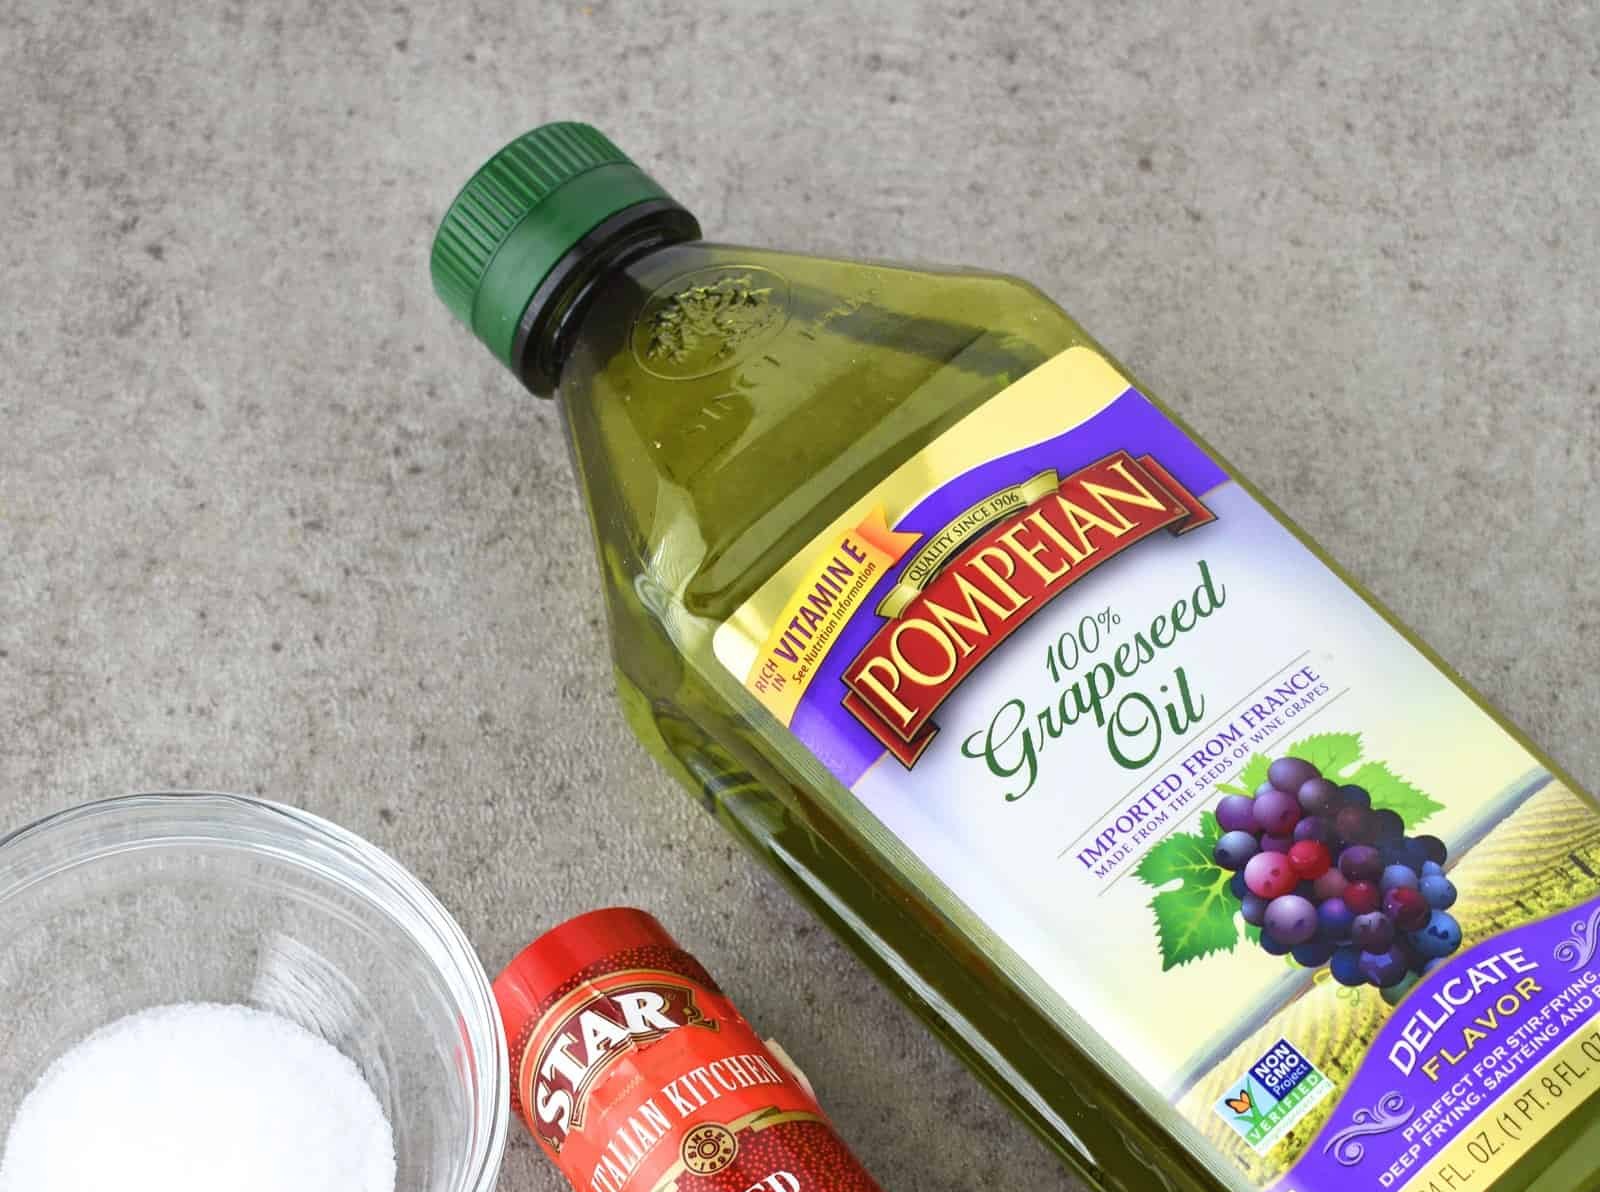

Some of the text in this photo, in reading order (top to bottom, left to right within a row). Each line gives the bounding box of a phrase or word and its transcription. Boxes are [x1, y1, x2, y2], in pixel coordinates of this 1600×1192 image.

[910, 491, 1020, 581] QUALITY SINCE 1906
[773, 538, 866, 664] VITAMIN E
[792, 562, 877, 685] See Nutrition Information
[855, 460, 1167, 729] POMPEIAN
[1046, 606, 1121, 683] 100%
[754, 658, 779, 694] RICH
[771, 673, 787, 693] IN
[961, 559, 1226, 802] Grapeseed
[1107, 666, 1205, 770] Oil
[1076, 666, 1320, 869] IMPORTED FROM FRANCE
[1094, 682, 1329, 879] MADE FROM THE SEEDS OF WINE GRAPES
[536, 991, 681, 1136] STAR
[1254, 1043, 1291, 1080] NON
[1388, 947, 1540, 1077] DELICATE
[1421, 976, 1543, 1082] FLAVOR
[661, 1054, 783, 1118] KITCHEN
[1250, 1074, 1319, 1140] VERIFIED
[1264, 1052, 1300, 1088] GMO
[1273, 1063, 1309, 1096] Project
[1378, 1143, 1422, 1188] DEEP
[1421, 1092, 1488, 1147] FRYING,
[1559, 995, 1593, 1027] AND
[1402, 1073, 1474, 1142] PERFECT
[1473, 1046, 1508, 1078] FOR
[1438, 1163, 1475, 1191] FL.
[1466, 1131, 1505, 1164] OZ.
[1496, 1112, 1523, 1141] (1
[1513, 1089, 1550, 1121] PT.
[1540, 1077, 1563, 1097] 8
[1553, 1060, 1590, 1087] FL.
